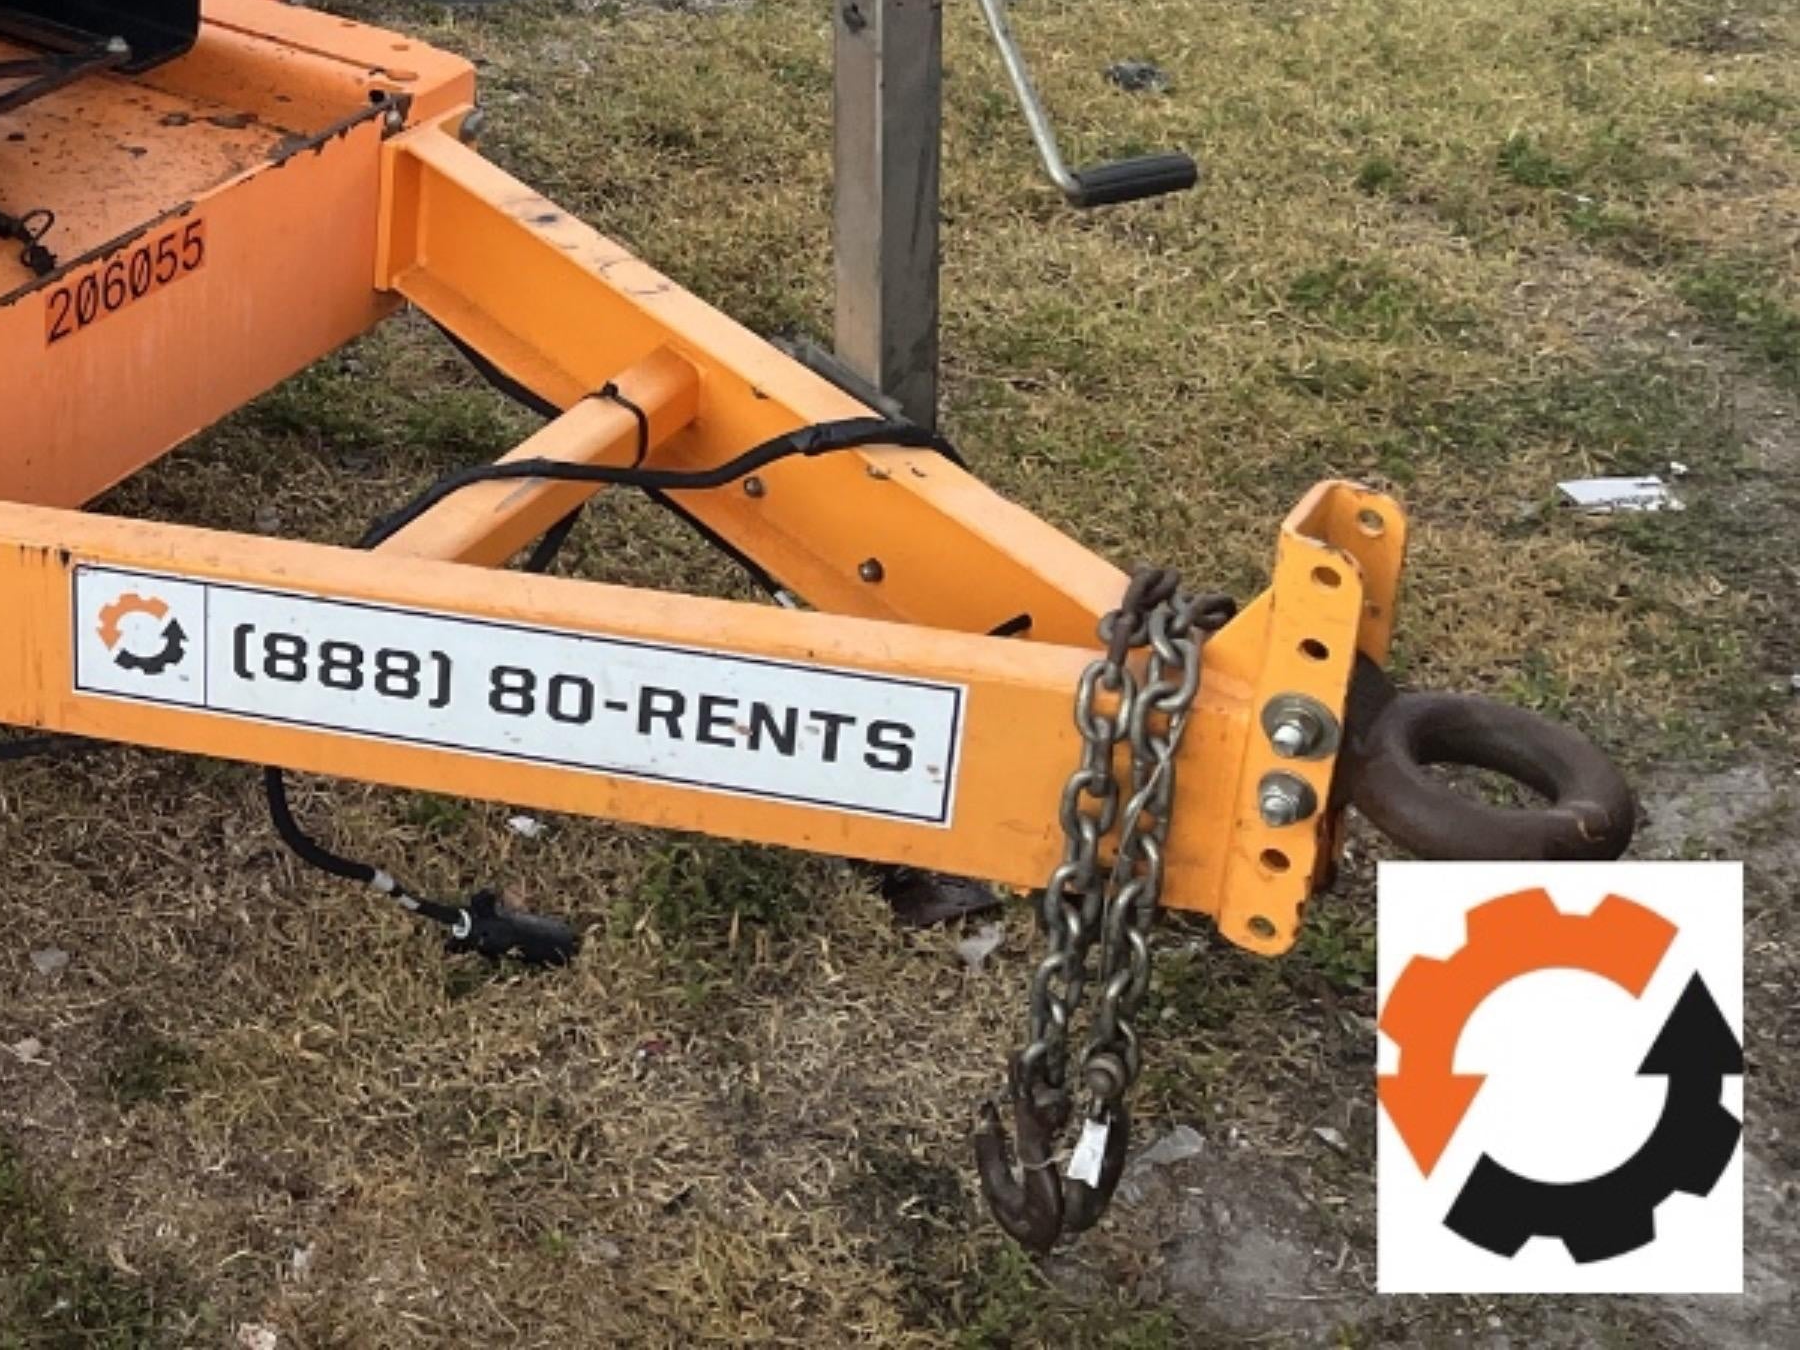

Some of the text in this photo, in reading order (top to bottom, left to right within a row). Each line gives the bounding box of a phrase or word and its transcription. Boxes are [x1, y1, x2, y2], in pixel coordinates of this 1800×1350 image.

[48, 218, 204, 346] 206055
[233, 623, 915, 772] (888) 80-RENTS
